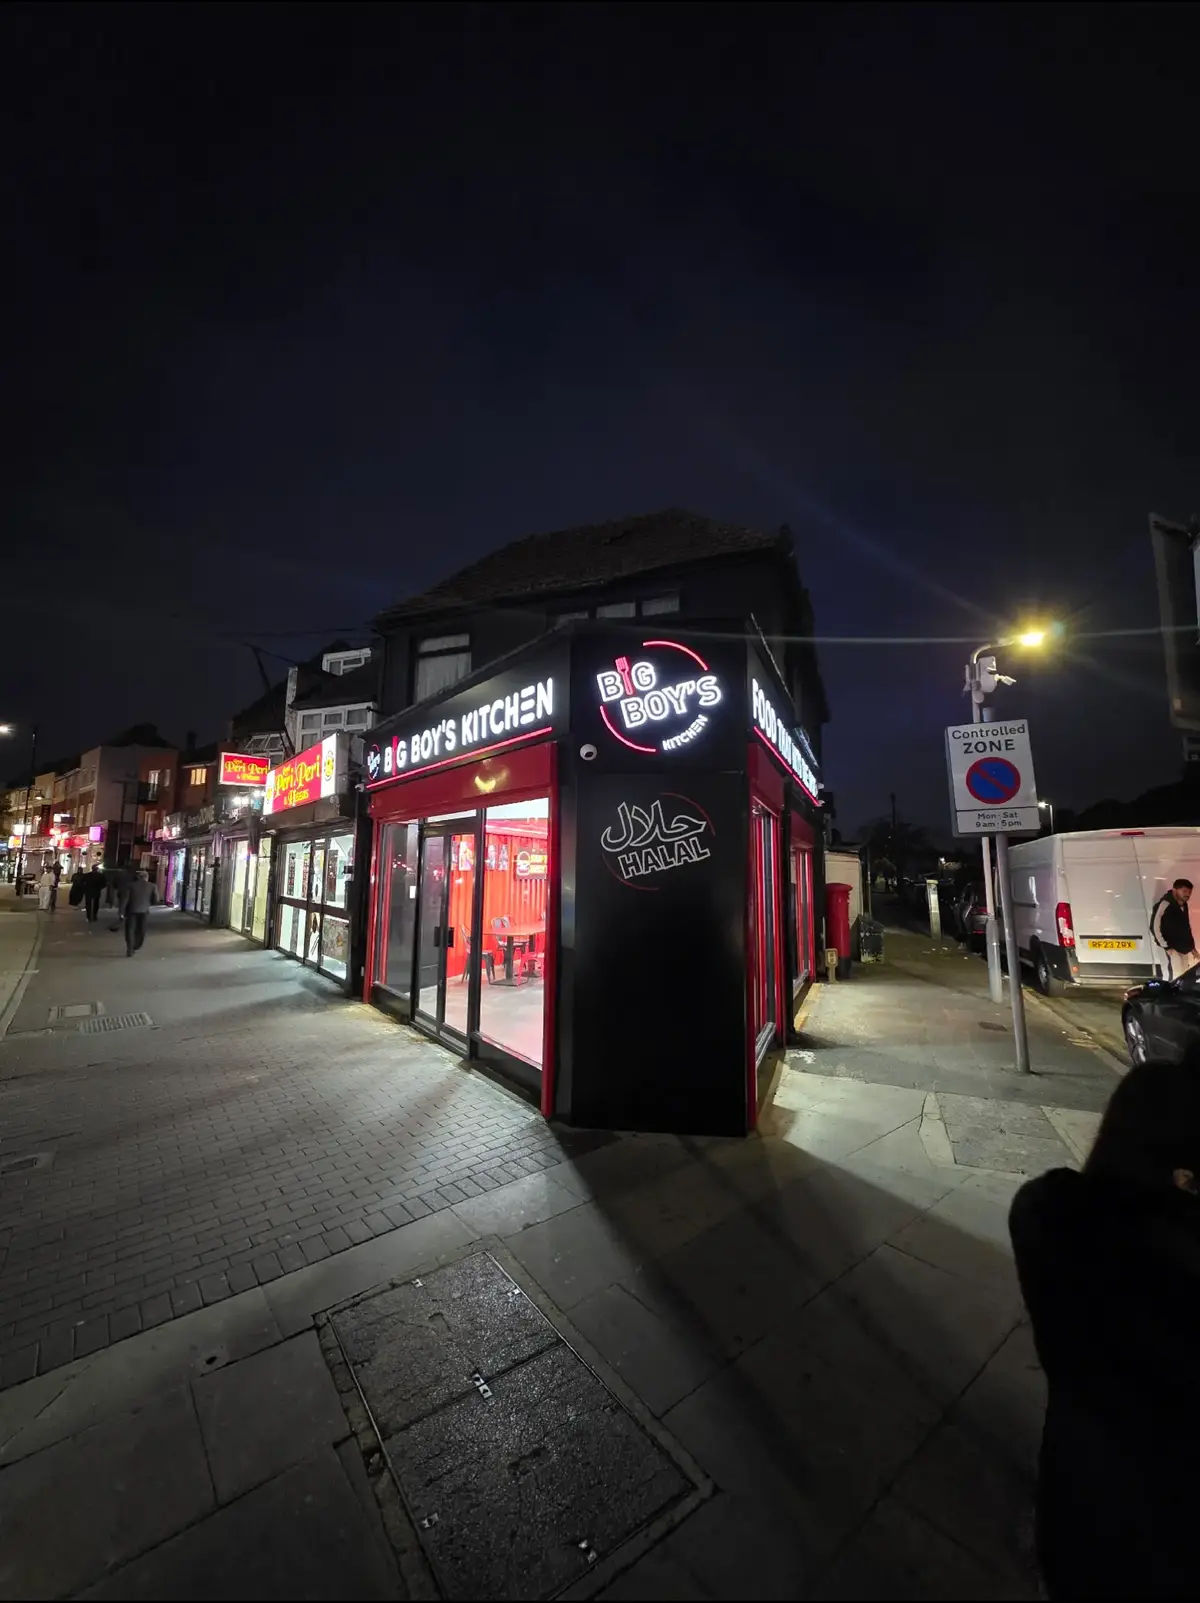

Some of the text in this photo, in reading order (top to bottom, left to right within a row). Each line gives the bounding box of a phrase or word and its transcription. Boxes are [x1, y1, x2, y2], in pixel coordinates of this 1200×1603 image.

[597, 656, 656, 702] BIG
[620, 675, 722, 729] BOY'S
[752, 678, 777, 744] FOOD
[384, 735, 407, 776] BIG
[410, 718, 456, 764] BOY'S
[461, 677, 554, 746] KITCHEN
[662, 714, 709, 751] KITCHEN
[952, 724, 1026, 740] Controlled
[963, 739, 1015, 754] ZONE
[224, 761, 246, 773] Peri
[248, 763, 268, 775] Peri
[274, 754, 320, 798] Peri Peri
[600, 800, 707, 852] حلال
[977, 812, 996, 820] Mon
[1002, 811, 1018, 819] Sat
[618, 836, 711, 879] HALAL
[1091, 941, 1133, 949] RF23 ZRX
